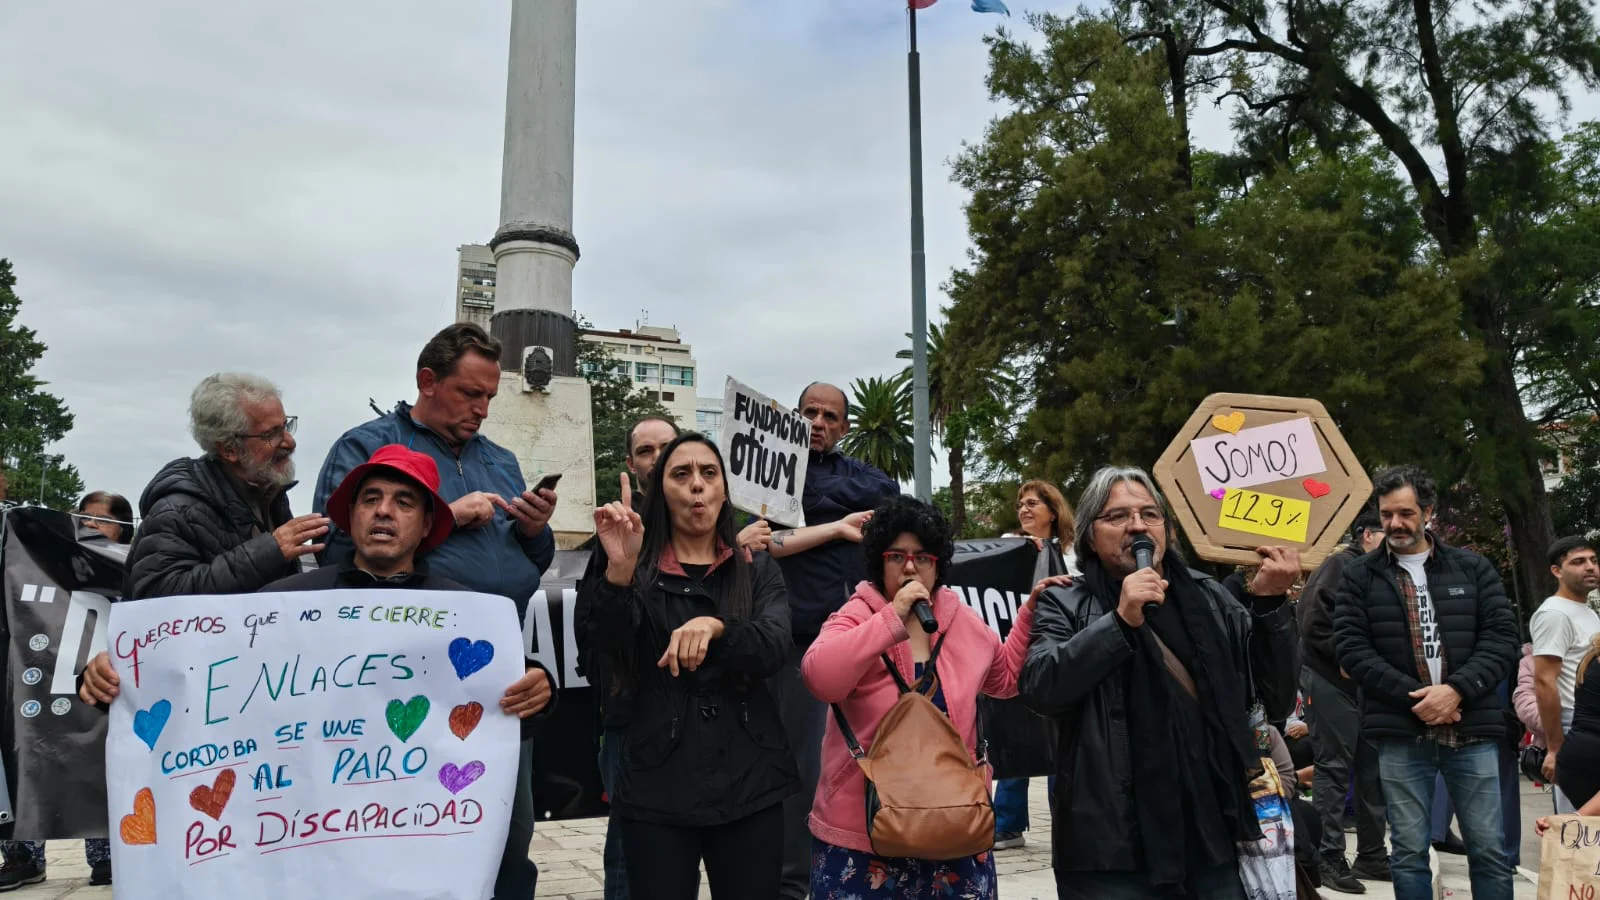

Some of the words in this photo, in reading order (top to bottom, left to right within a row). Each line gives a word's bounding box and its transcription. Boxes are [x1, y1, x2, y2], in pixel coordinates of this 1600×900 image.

[1204, 432, 1298, 484] SOMOS
[299, 608, 322, 622] NO
[337, 605, 364, 620] SE
[274, 721, 308, 744] SE
[322, 718, 367, 738] UNE
[331, 744, 428, 785] PARO
[185, 820, 237, 860] POR
